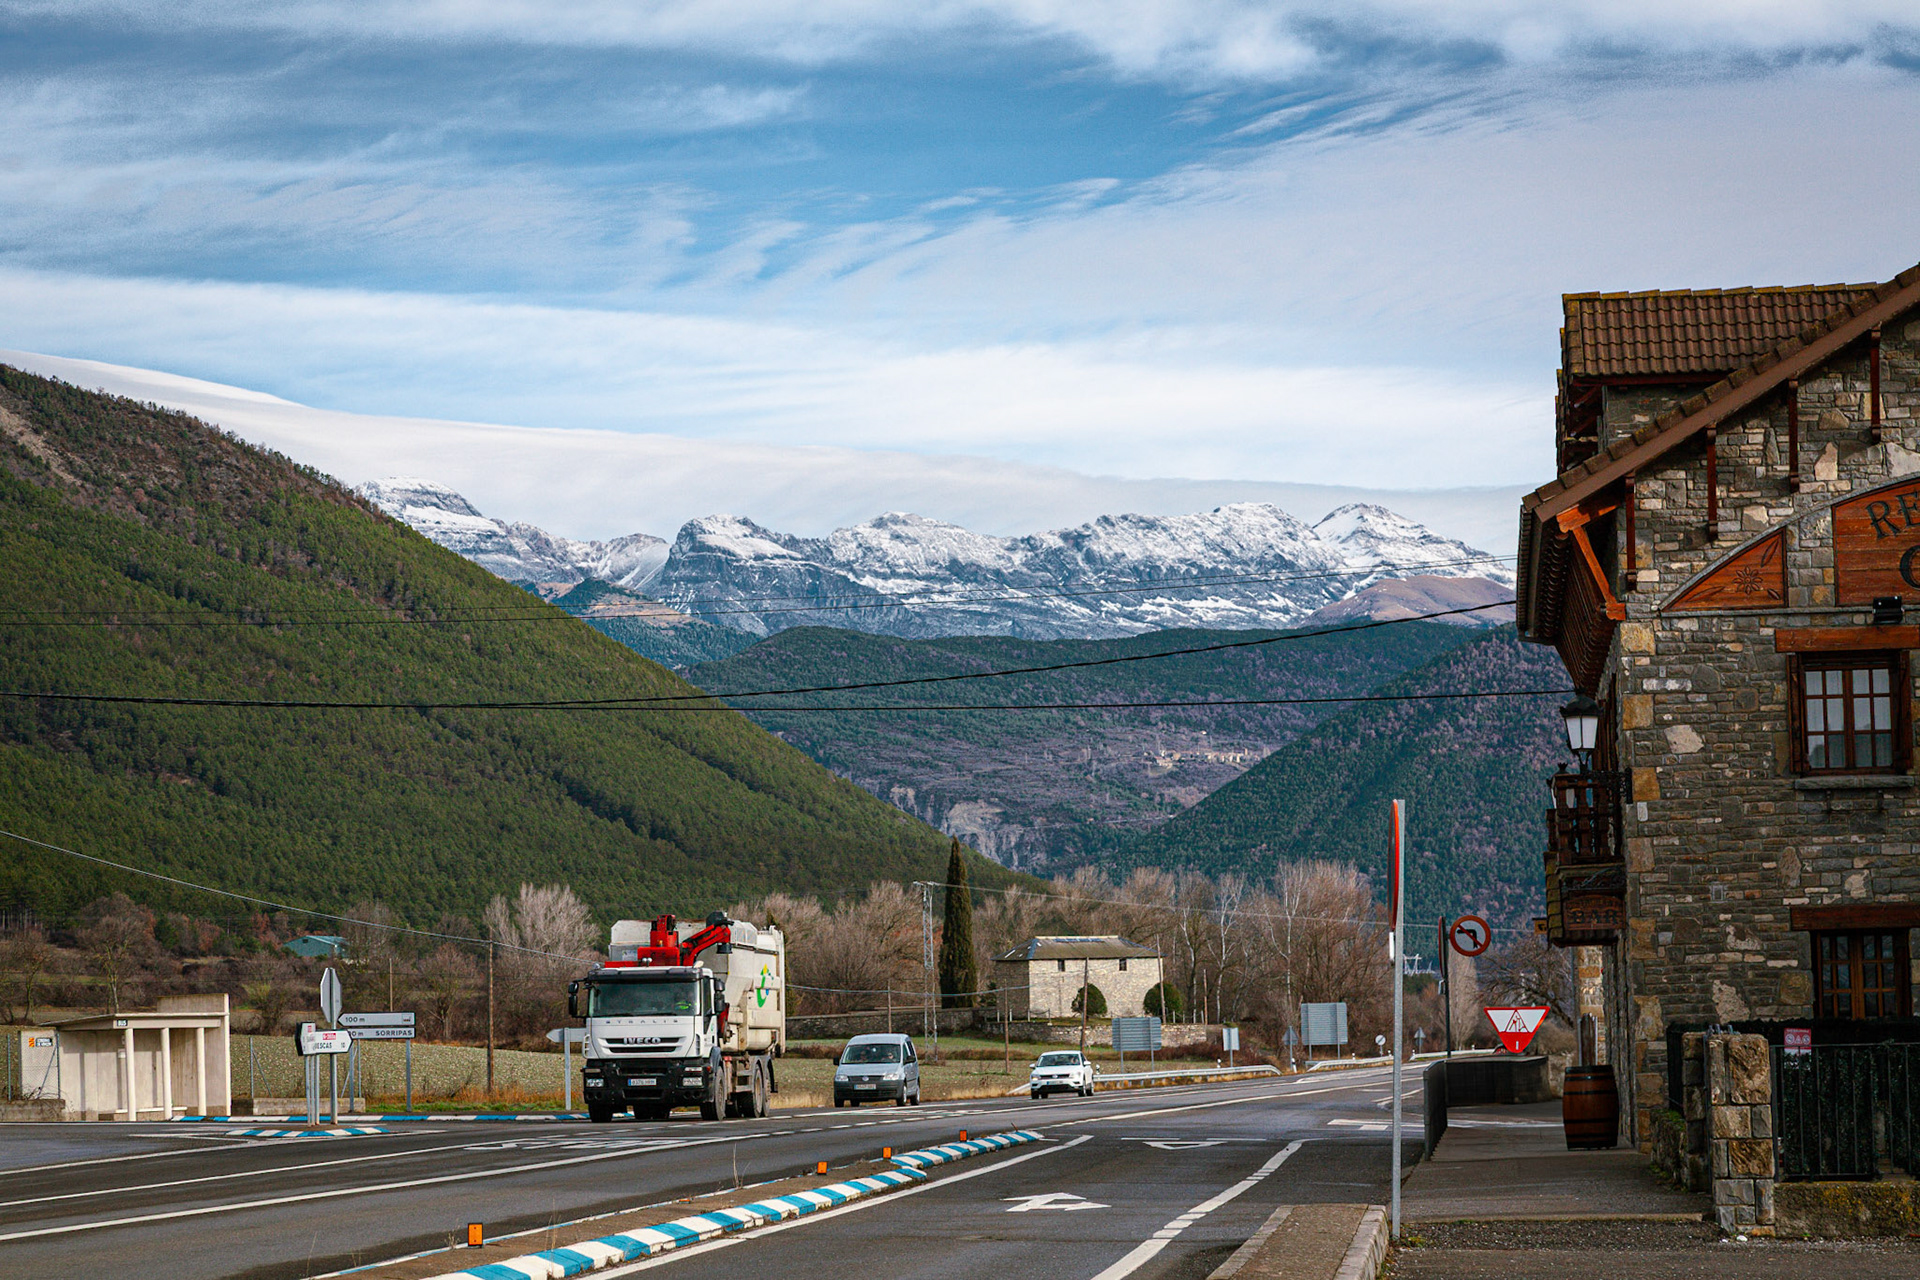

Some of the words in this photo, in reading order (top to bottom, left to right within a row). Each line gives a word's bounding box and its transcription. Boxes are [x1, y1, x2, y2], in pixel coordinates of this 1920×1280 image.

[1866, 491, 1920, 540] RE
[1572, 909, 1618, 924] BAR
[375, 1029, 413, 1037] SORRIPAS
[623, 1036, 662, 1045] IVECO
